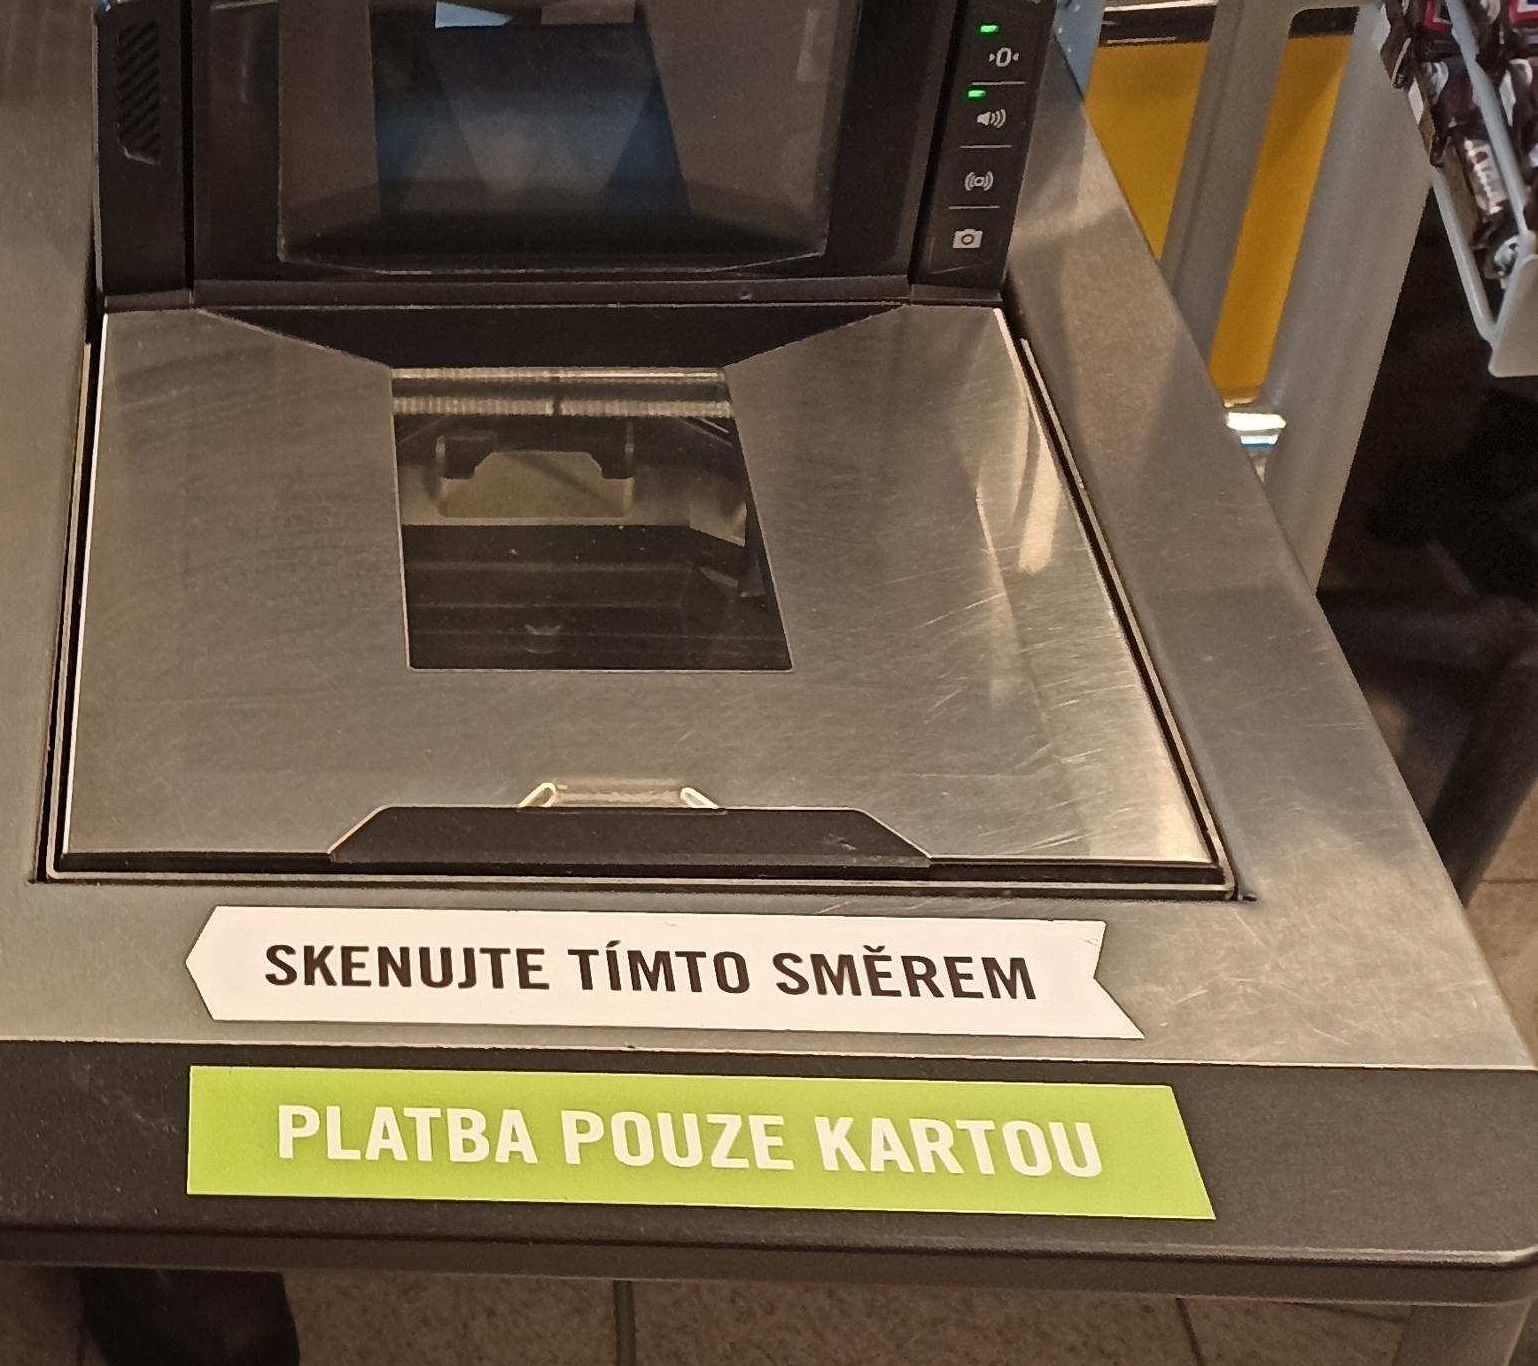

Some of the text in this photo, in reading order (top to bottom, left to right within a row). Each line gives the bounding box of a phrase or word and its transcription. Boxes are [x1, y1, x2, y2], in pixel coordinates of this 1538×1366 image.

[264, 939, 1037, 1002] SKENUJTE TÍMTO SMĚREM
[275, 1103, 1104, 1181] PLATBA POUZE KARTOU
